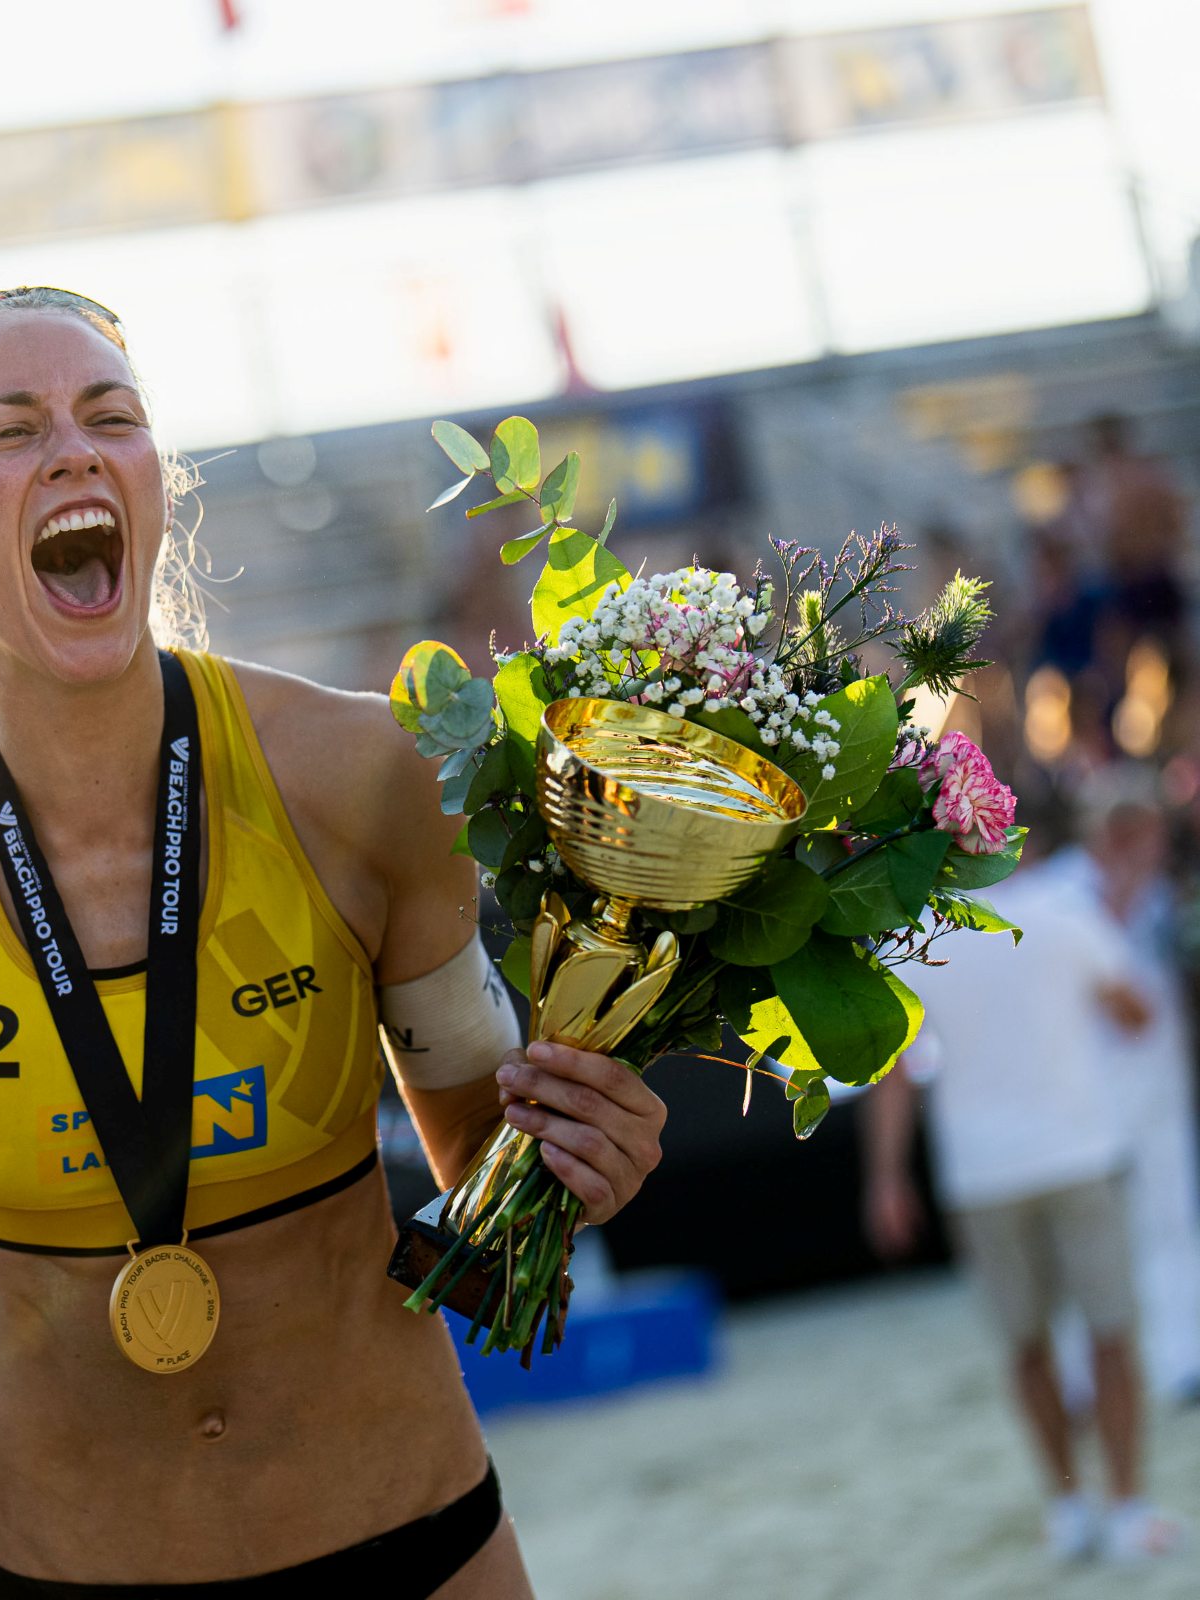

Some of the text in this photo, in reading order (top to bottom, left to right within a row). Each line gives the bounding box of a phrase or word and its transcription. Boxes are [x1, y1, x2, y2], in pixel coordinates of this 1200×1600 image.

[161, 878, 180, 935] TOUR
[41, 938, 73, 997] TOUR
[231, 964, 323, 1018] GER
[127, 1264, 145, 1286] TOUR
[144, 1252, 171, 1267] BADEN
[174, 1252, 210, 1287] CHALLENGE
[120, 1289, 130, 1309] PRO
[120, 1312, 133, 1343] BEACH
[167, 1350, 191, 1366] PLACE
